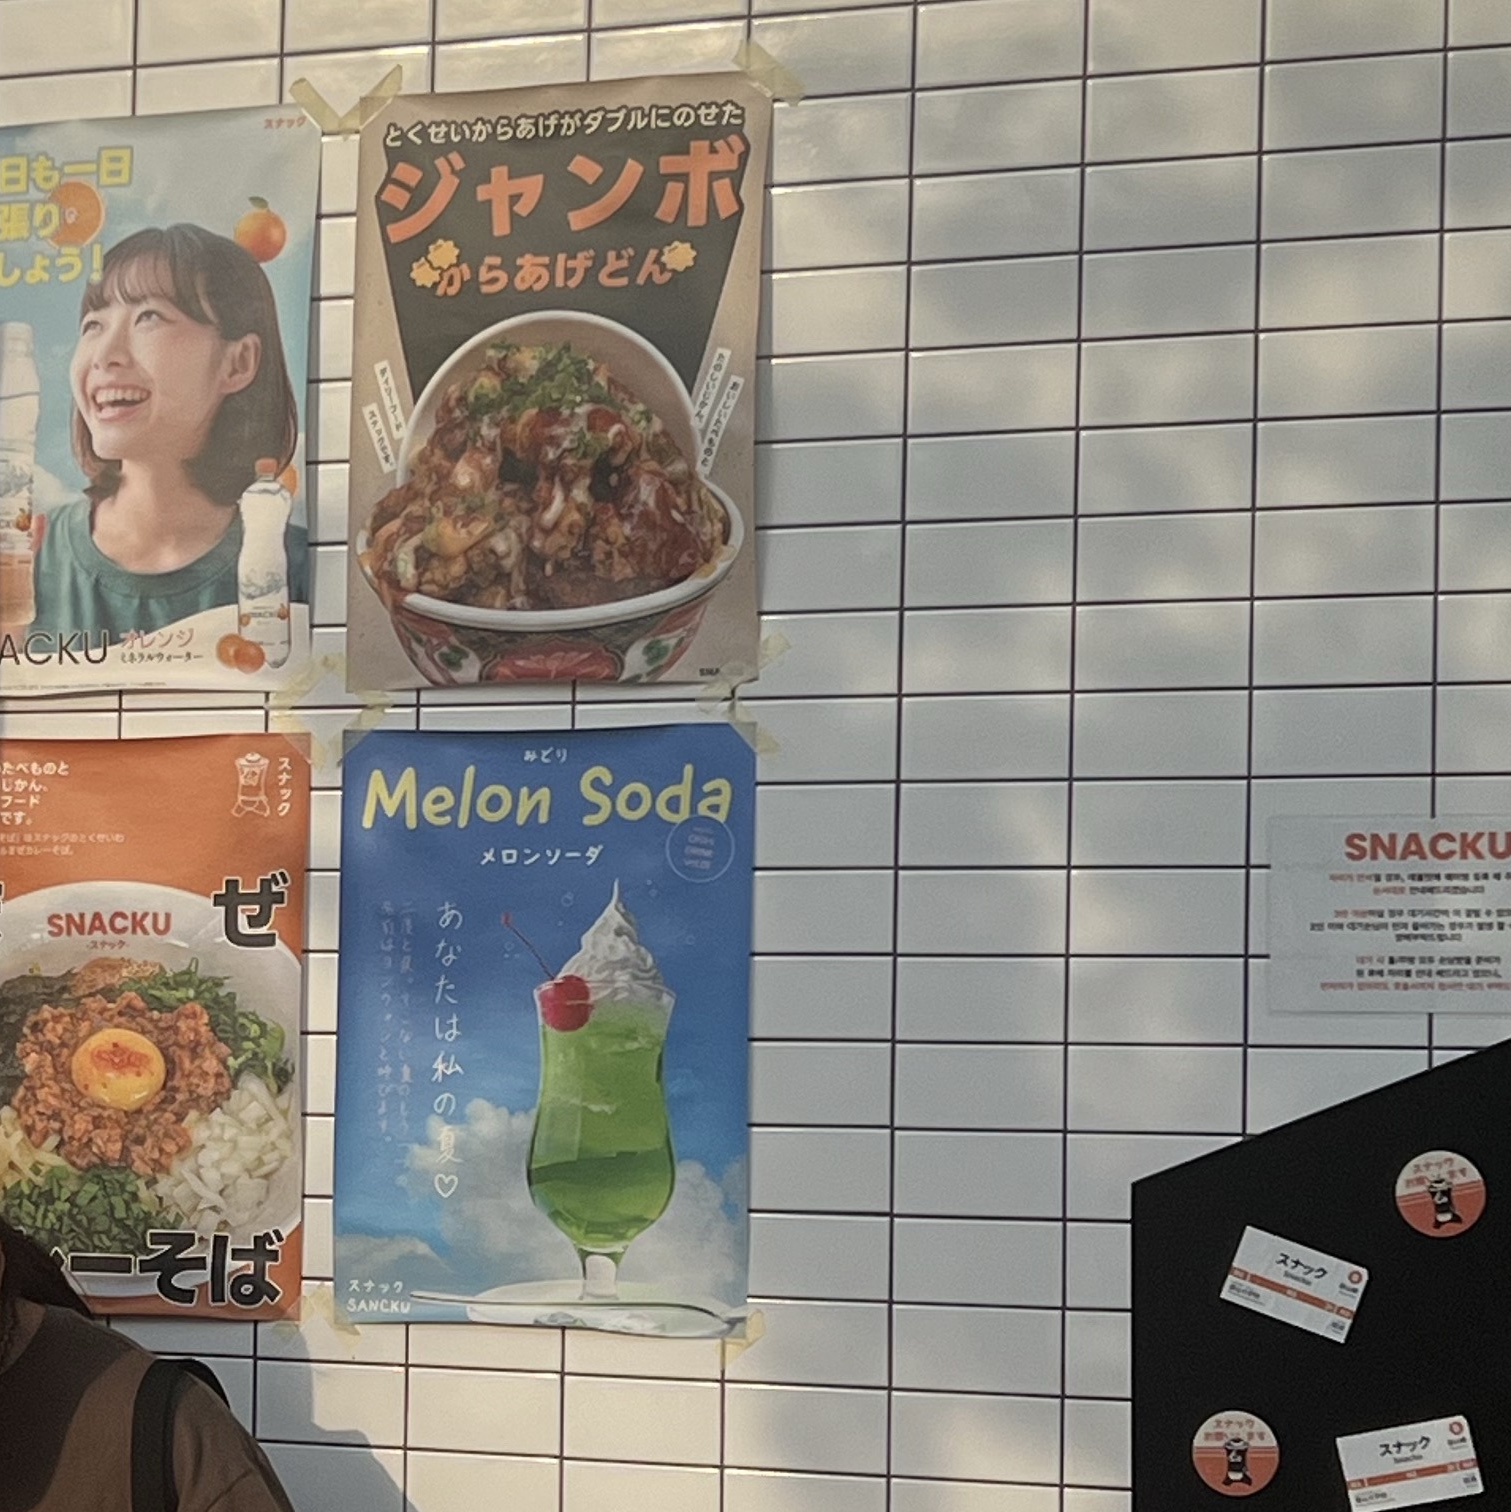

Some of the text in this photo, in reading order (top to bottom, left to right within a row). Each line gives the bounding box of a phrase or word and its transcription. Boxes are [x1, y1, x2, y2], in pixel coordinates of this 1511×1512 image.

[384, 101, 745, 147] とくせいからあげがダブルにのせた
[378, 134, 746, 244] ジャンボ
[435, 246, 674, 298] からあげどん
[119, 628, 195, 649] オレンジ
[523, 747, 568, 764] みどり
[277, 757, 292, 816] スナック
[361, 763, 734, 831] Melon Soda
[480, 844, 605, 867] メロンソーダ
[1344, 831, 1511, 862] SNACKU
[46, 909, 174, 940] SNACKU
[213, 870, 290, 949] ぜ
[51, 1228, 285, 1307] ーそば
[1275, 1252, 1329, 1280] スナック
[348, 1279, 404, 1294] スナック
[346, 1298, 412, 1314] SANCKU
[1379, 1436, 1432, 1457] スナック
